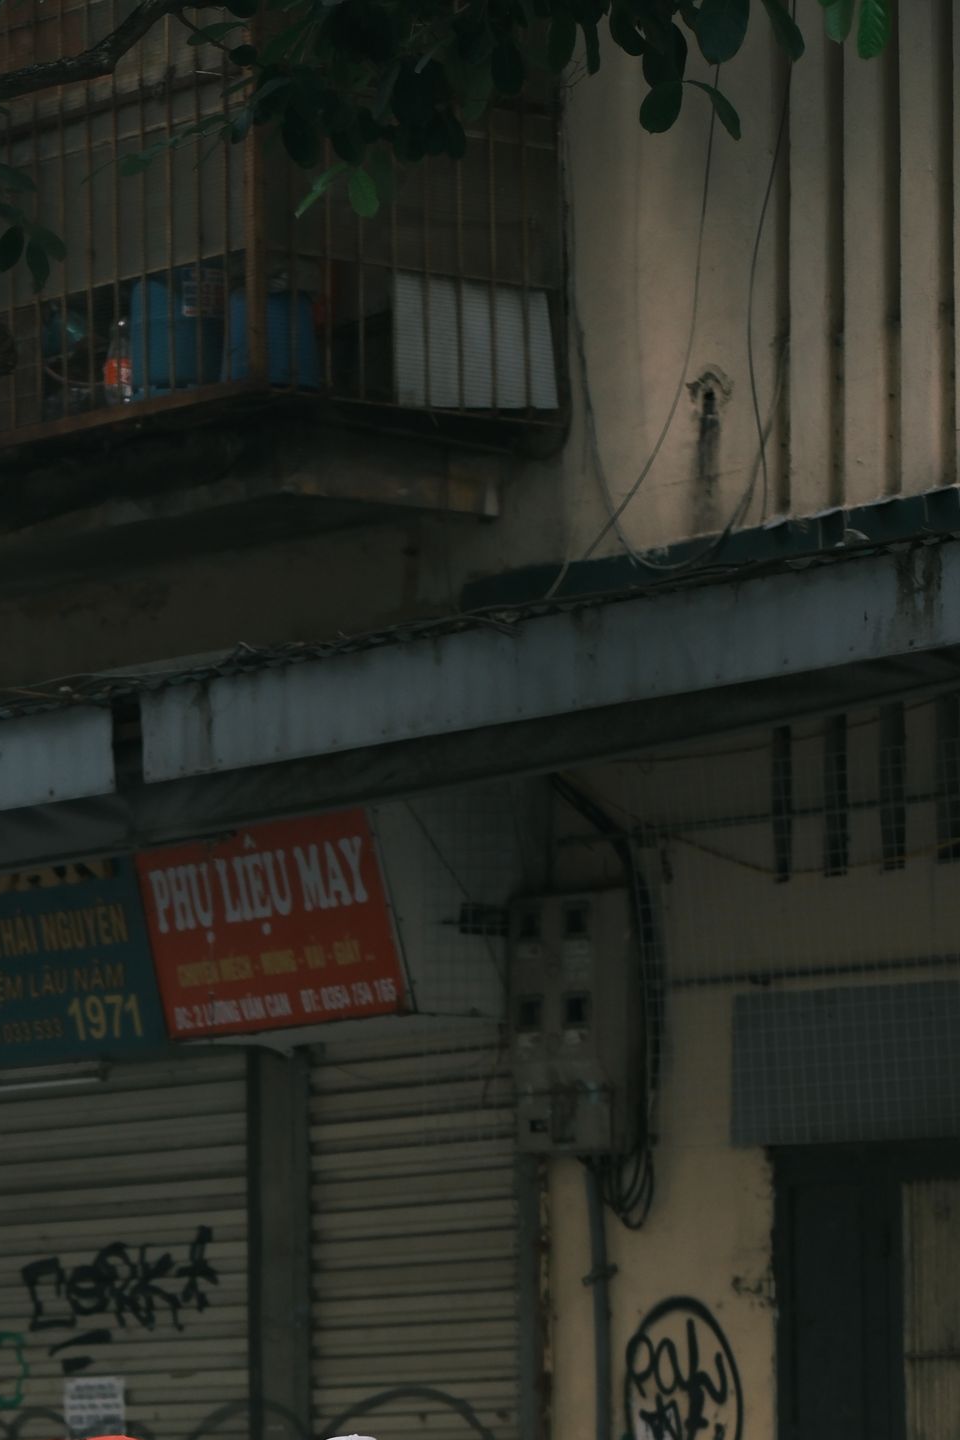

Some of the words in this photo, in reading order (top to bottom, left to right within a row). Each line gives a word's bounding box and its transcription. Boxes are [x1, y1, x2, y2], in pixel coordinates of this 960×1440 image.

[148, 862, 215, 944] PHỤ
[214, 834, 293, 936] LIỆU
[293, 836, 368, 912] MAY
[40, 897, 129, 952] NGUYÊN
[28, 964, 68, 998] LÂU
[67, 993, 144, 1041] 1971
